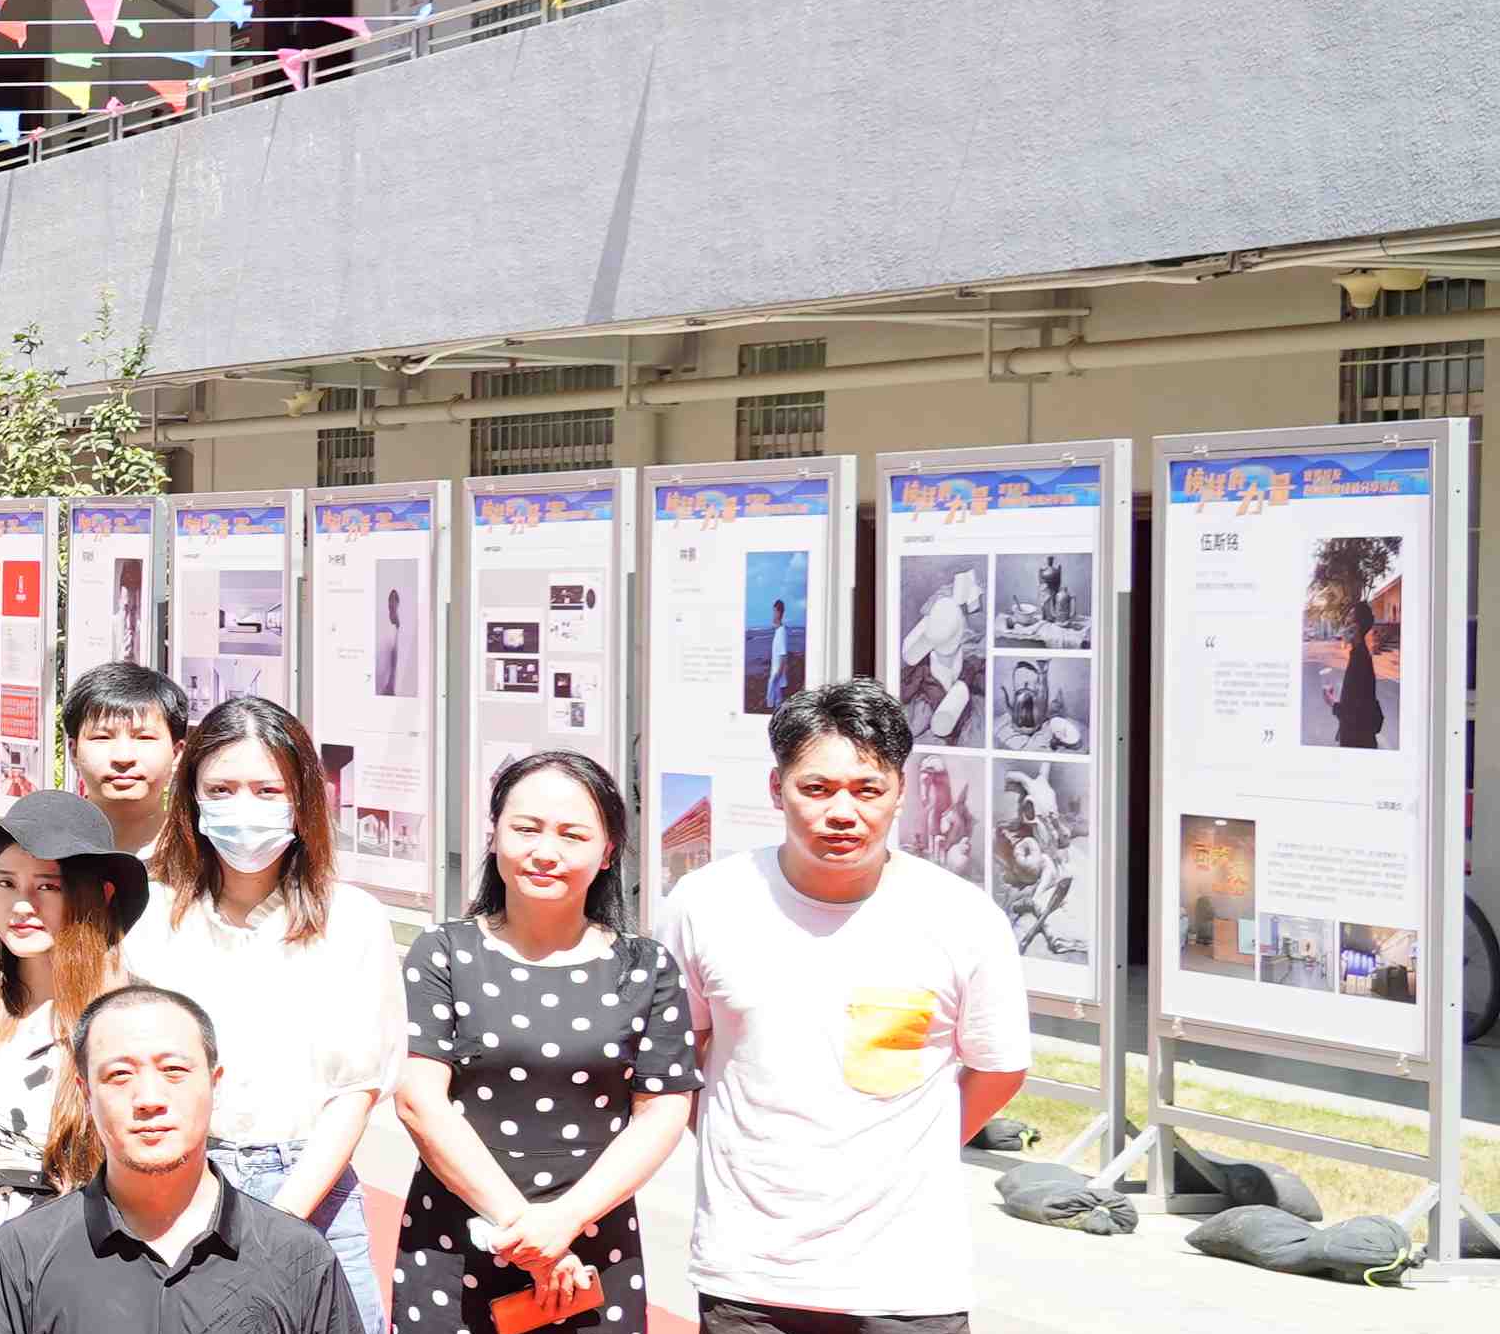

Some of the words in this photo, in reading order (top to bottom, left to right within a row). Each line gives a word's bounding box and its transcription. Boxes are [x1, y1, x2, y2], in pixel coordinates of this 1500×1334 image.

[1184, 467, 1297, 517] 榜样的力量
